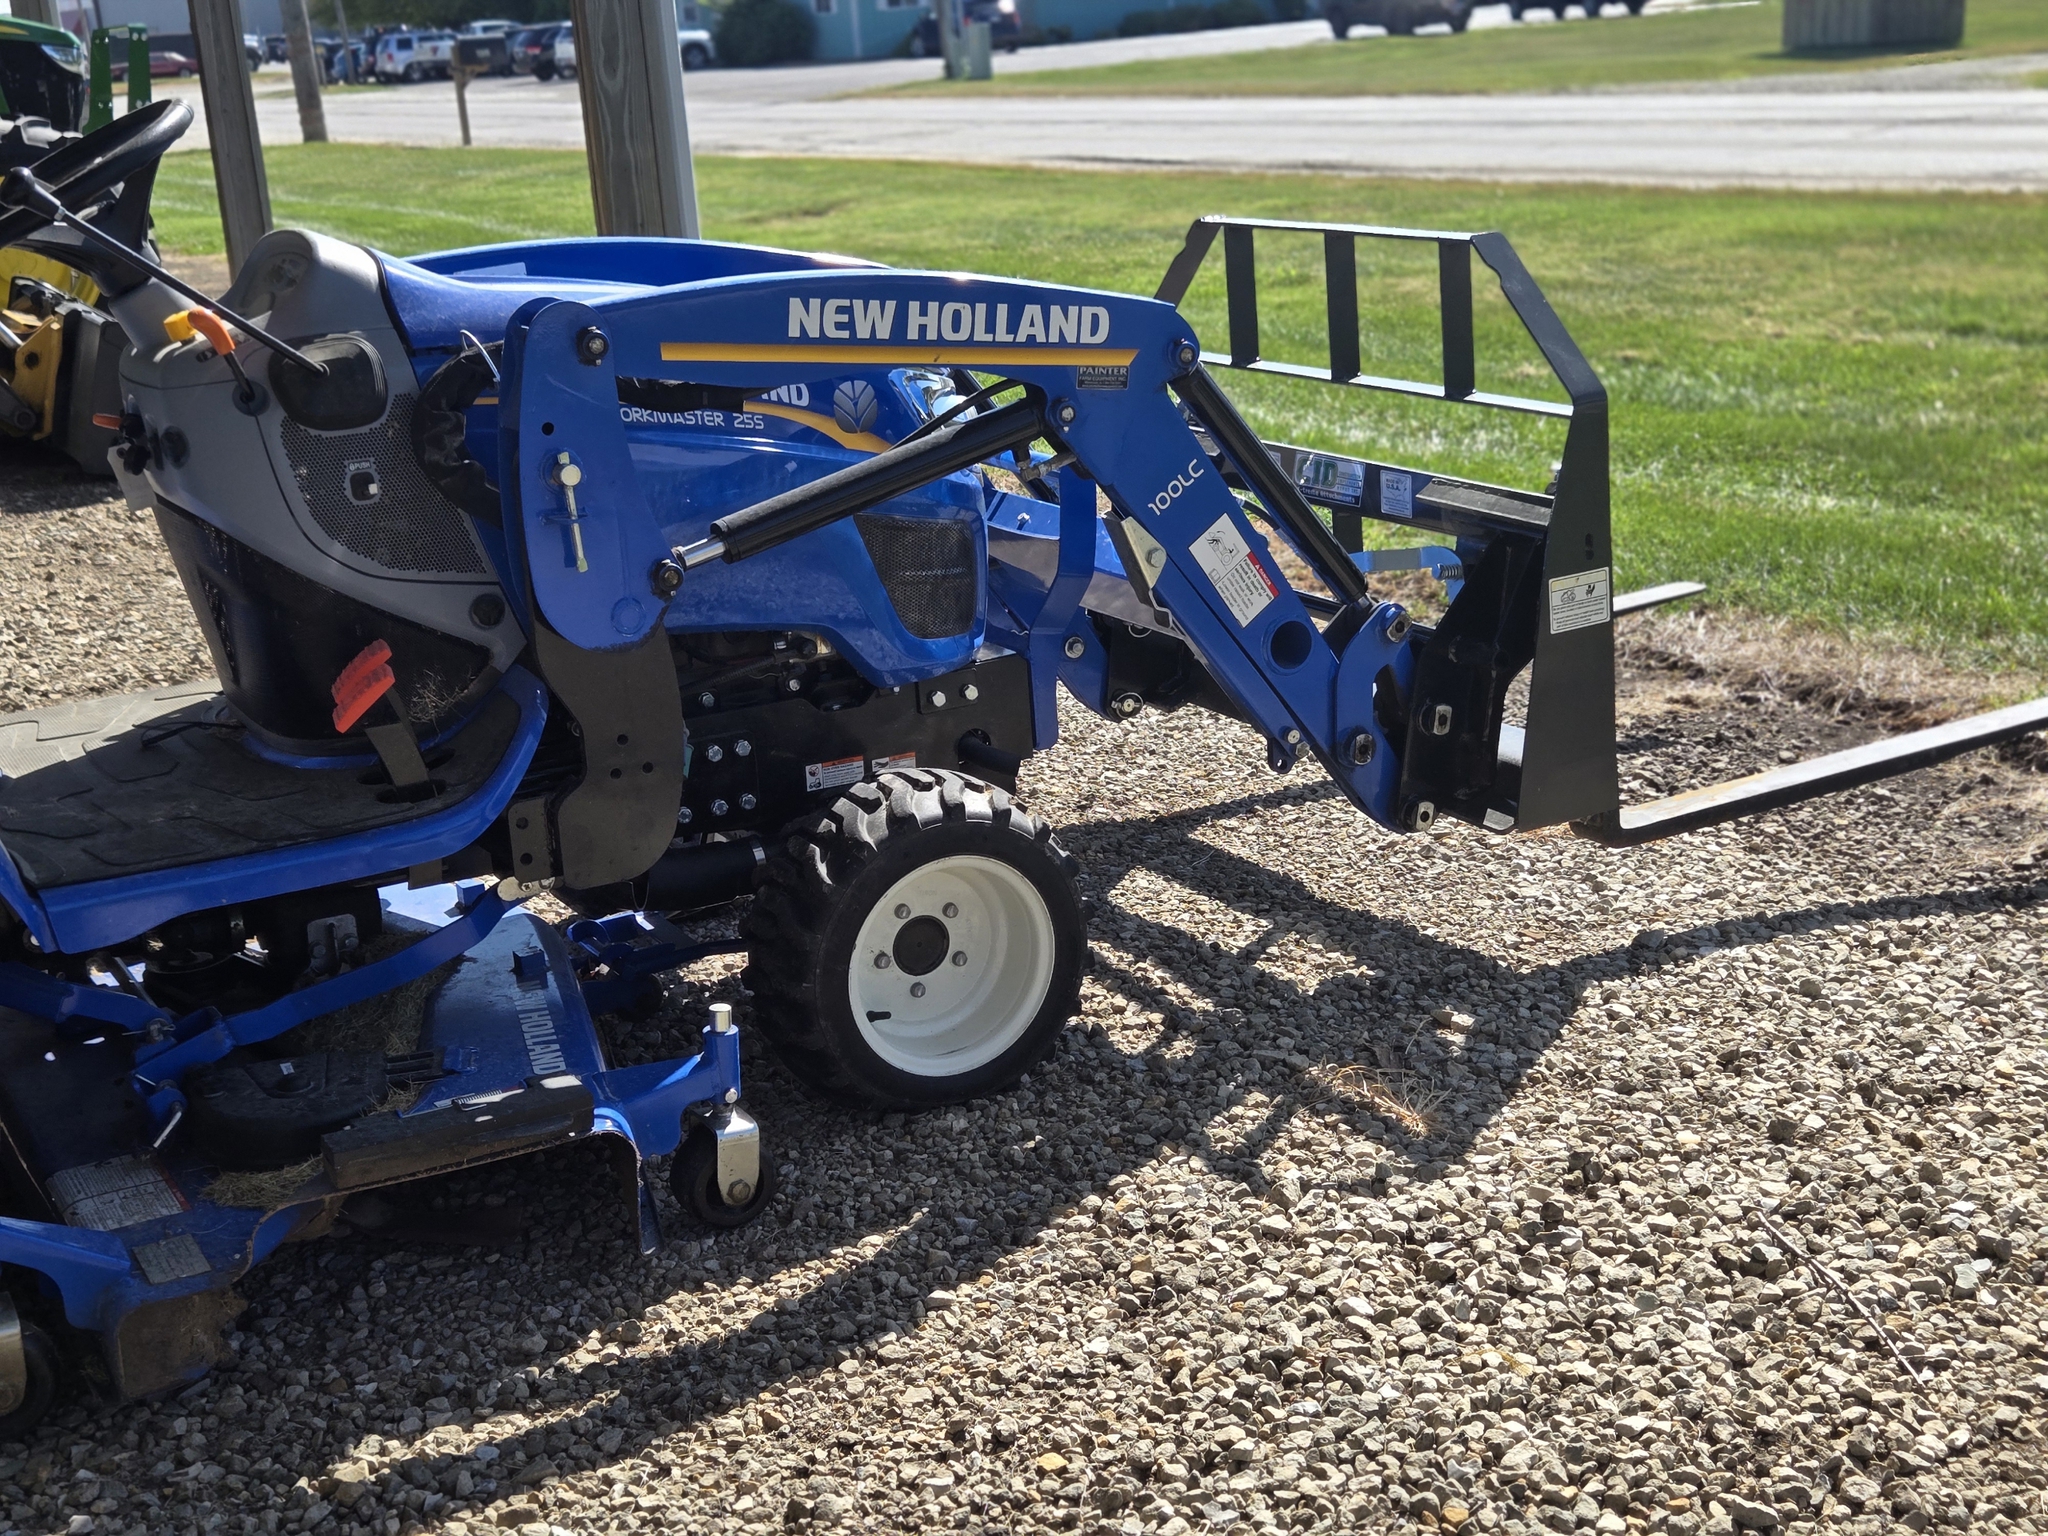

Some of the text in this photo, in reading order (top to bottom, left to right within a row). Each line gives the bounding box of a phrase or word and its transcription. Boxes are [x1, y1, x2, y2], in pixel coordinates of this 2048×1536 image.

[788, 298, 1110, 344] NEW HOLLAND
[1079, 366, 1127, 375] PAINTER
[620, 407, 765, 430] ORKMASTER 25S
[1147, 458, 1204, 516] 100LC
[1242, 558, 1254, 574] Failure
[1254, 577, 1267, 594] comply
[1258, 567, 1271, 586] DANGER
[512, 980, 567, 1075] NEW HOLLAND
